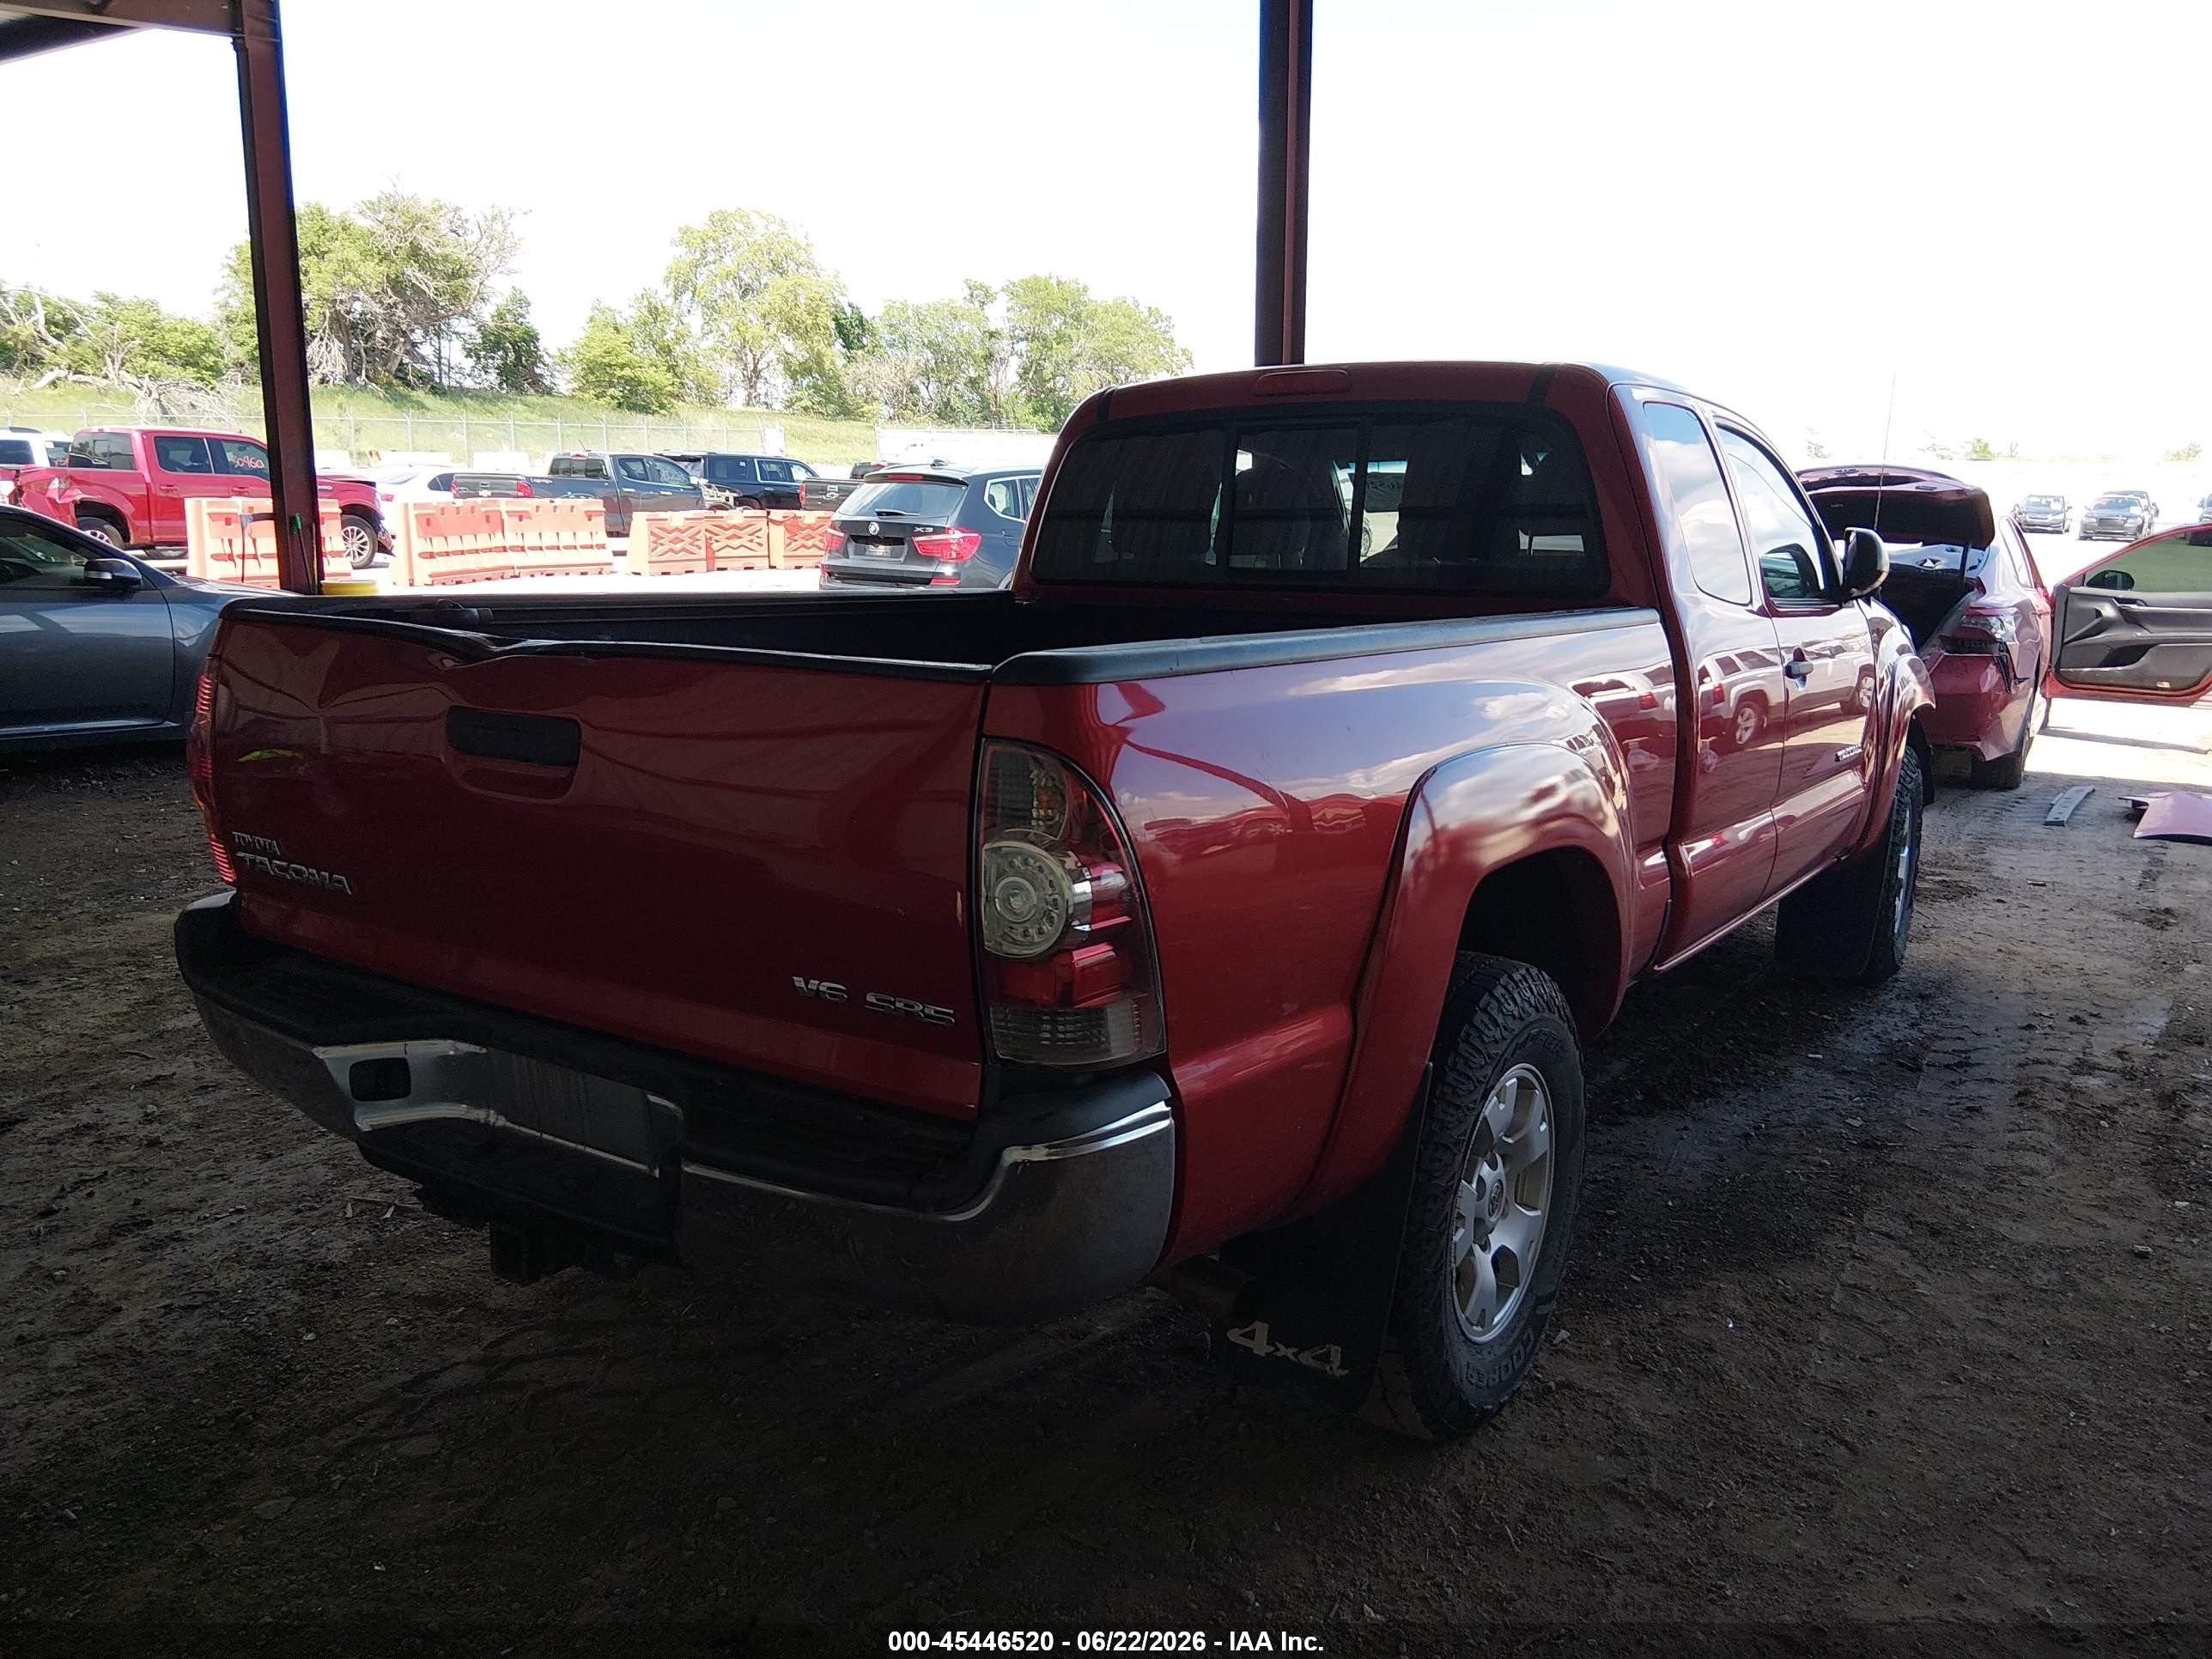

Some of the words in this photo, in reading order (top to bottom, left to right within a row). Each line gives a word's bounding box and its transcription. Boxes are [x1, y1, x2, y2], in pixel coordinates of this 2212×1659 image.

[235, 850, 354, 896] TACOMA
[792, 975, 849, 1003] V6
[864, 991, 957, 1026] SR5
